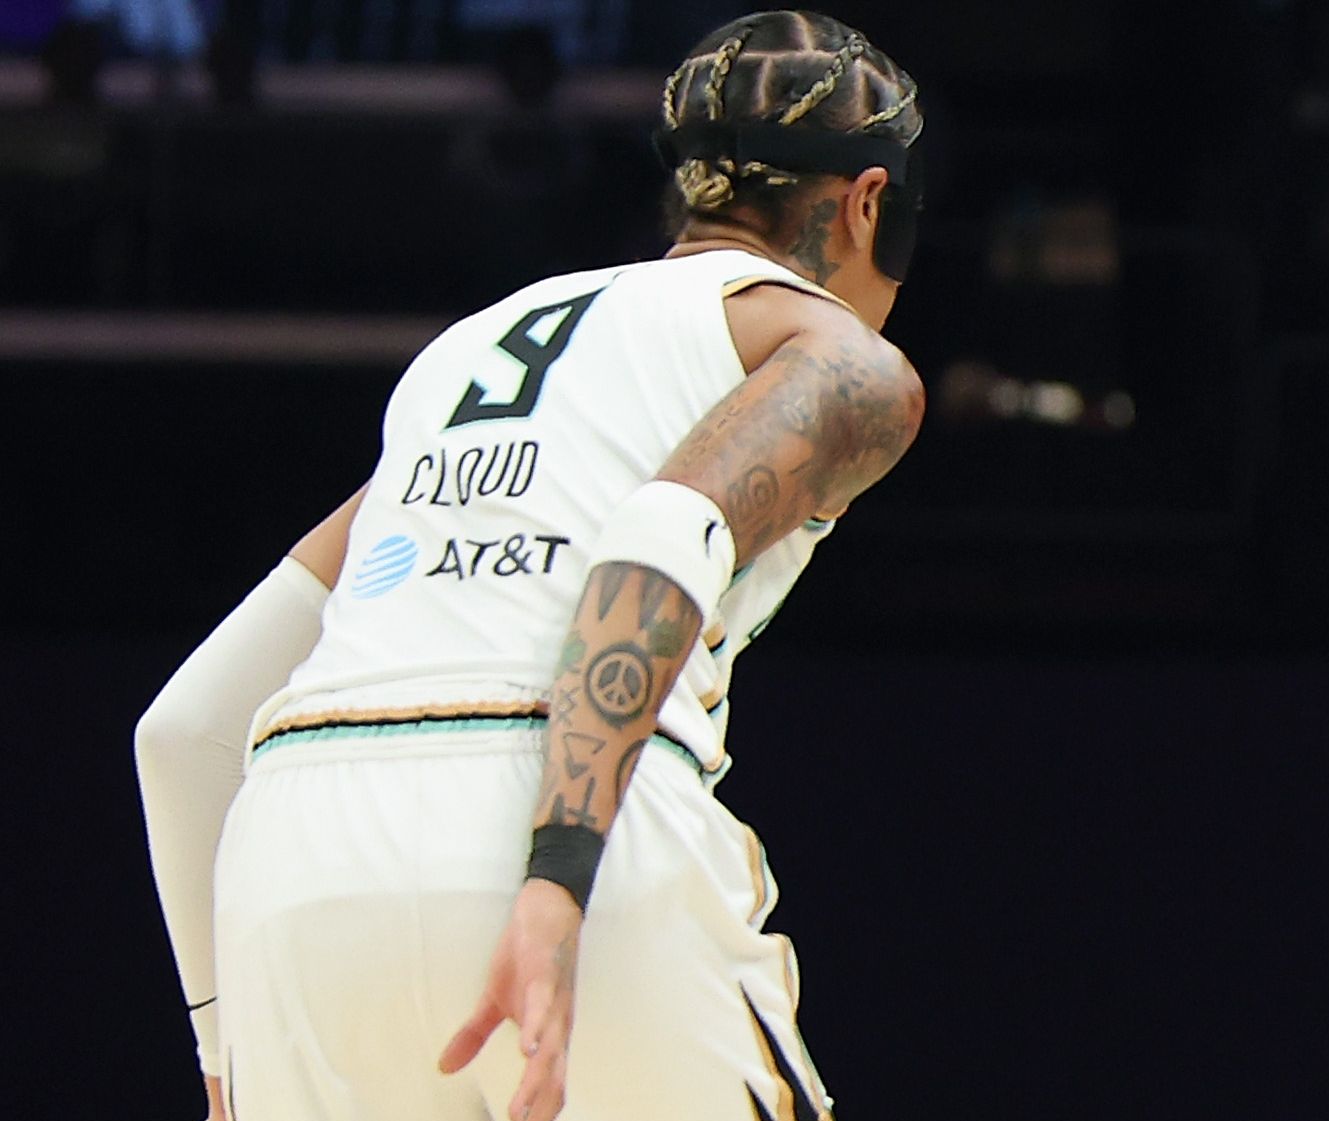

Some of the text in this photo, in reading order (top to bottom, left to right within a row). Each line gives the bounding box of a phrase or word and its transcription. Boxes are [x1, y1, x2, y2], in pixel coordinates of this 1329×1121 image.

[443, 286, 604, 433] 9
[401, 440, 540, 508] CLOUD
[425, 534, 572, 581] AT&T
